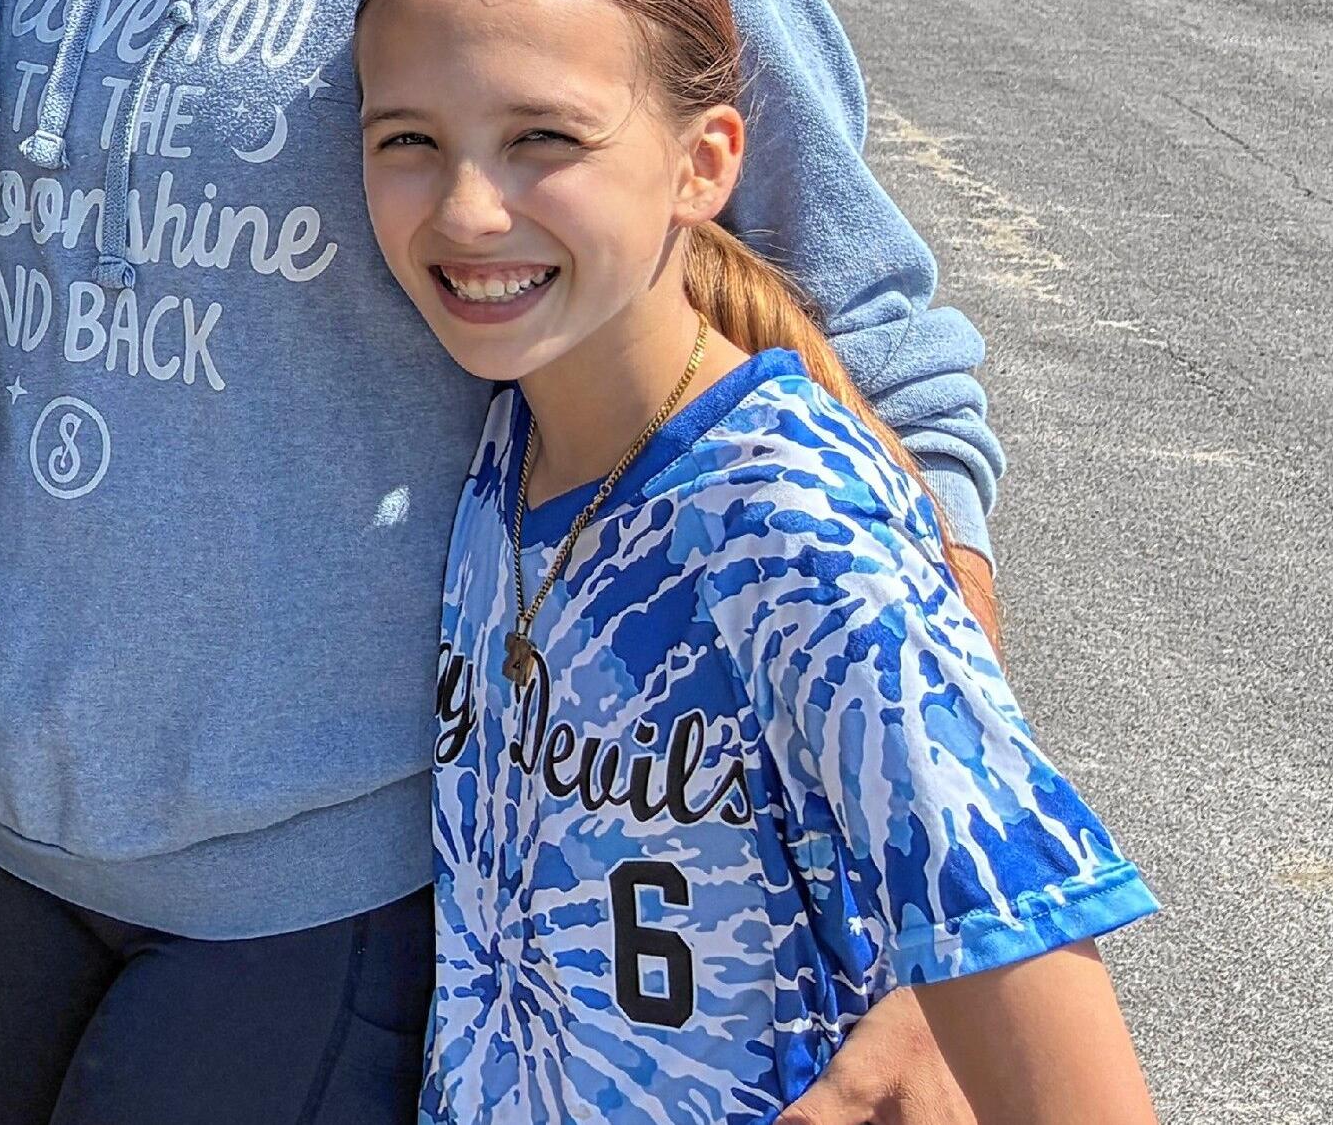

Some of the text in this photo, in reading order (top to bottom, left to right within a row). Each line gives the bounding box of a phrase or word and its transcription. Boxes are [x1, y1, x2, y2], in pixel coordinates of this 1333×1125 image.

[100, 75, 207, 158] THE
[64, 280, 227, 392] BACK
[609, 860, 695, 1030] 6
